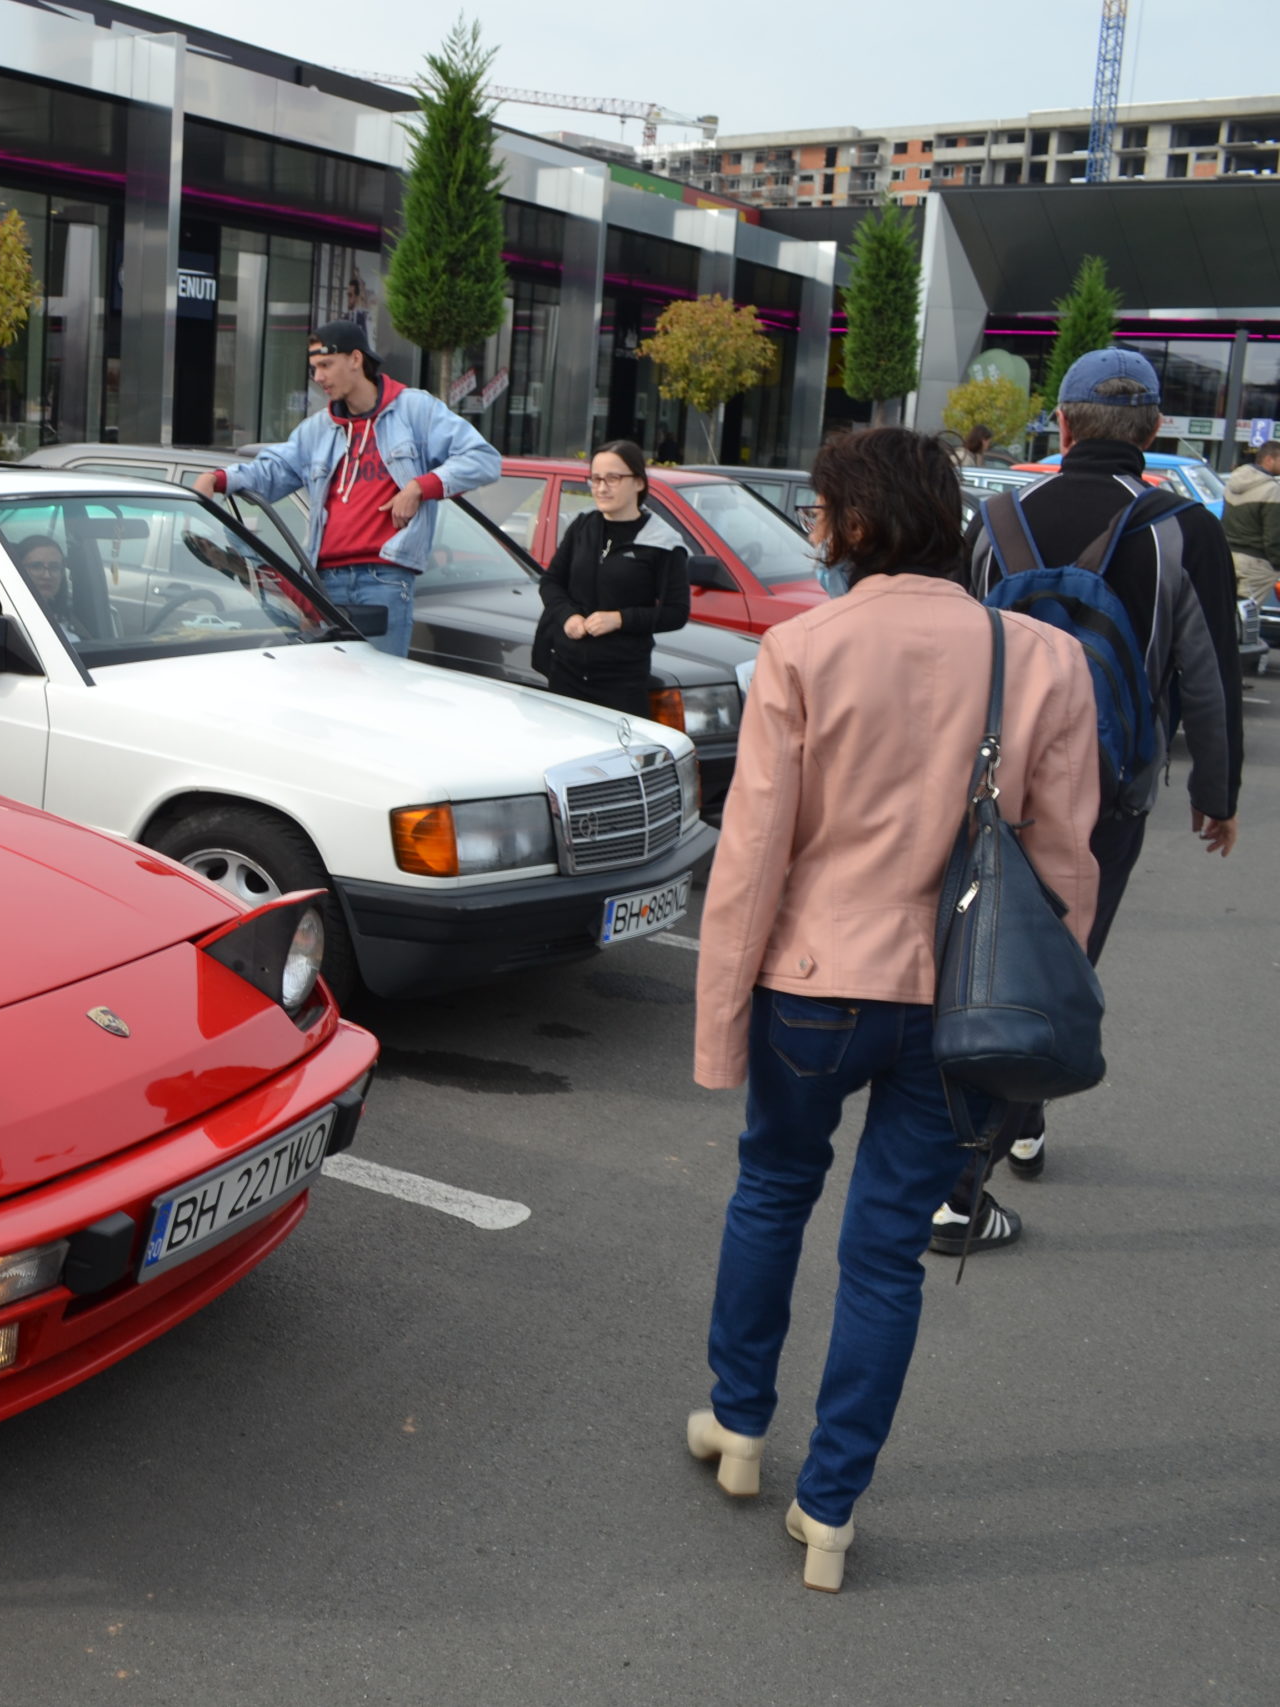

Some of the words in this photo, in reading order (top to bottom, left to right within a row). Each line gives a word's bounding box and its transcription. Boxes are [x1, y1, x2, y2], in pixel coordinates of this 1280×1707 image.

[178, 274, 217, 301] ENUTI
[613, 898, 643, 934] BH
[166, 1181, 225, 1252] BH
